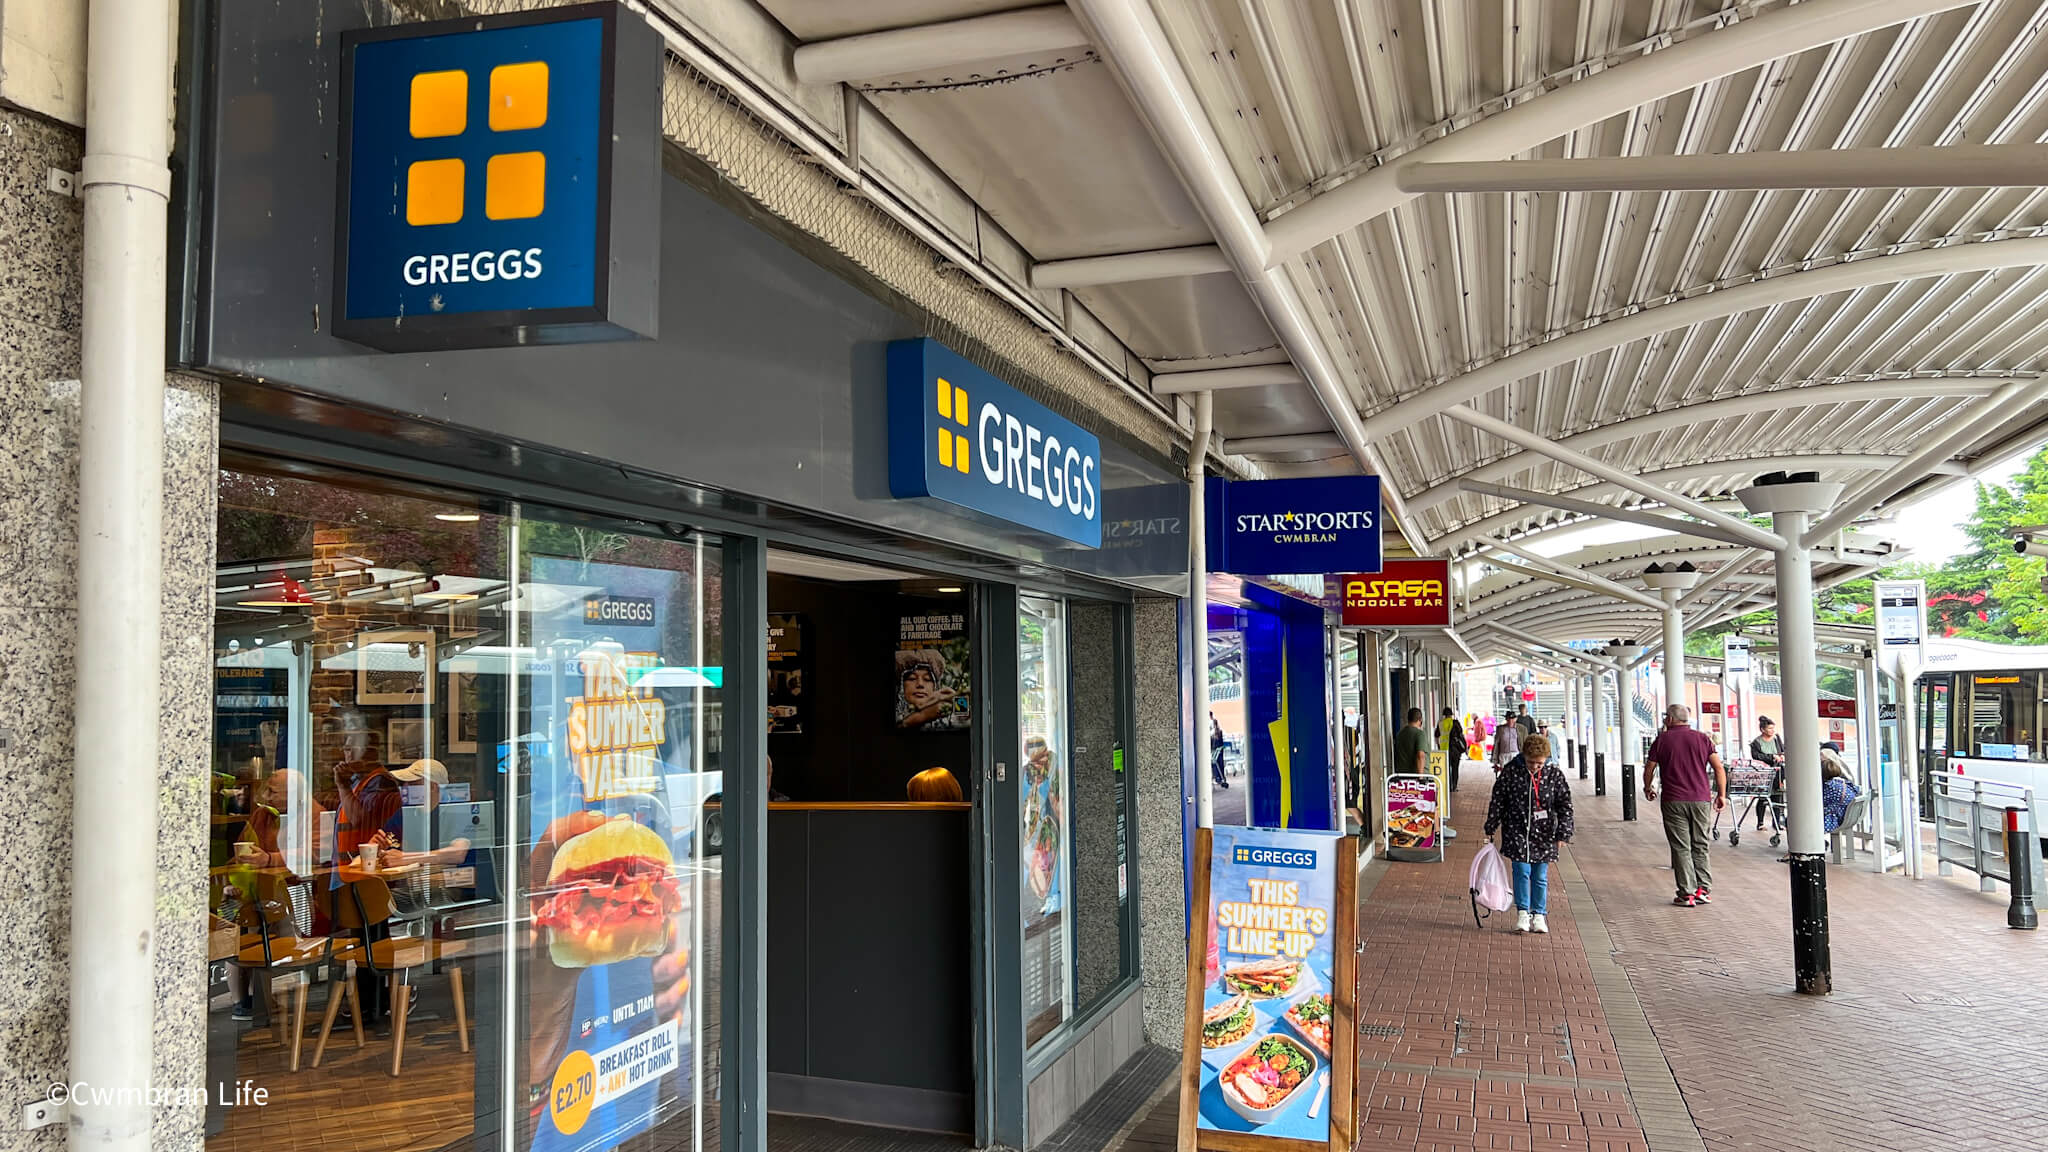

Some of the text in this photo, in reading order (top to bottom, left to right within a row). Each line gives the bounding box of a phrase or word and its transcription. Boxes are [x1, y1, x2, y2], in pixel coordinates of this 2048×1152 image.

[403, 247, 543, 286] GREGGS
[978, 402, 1096, 521] GREGGS
[1236, 510, 1373, 533] STAR SPORTS
[1273, 533, 1337, 544] CWMBRAN
[1346, 579, 1443, 599] ASAGA
[600, 600, 653, 621] GREGGS
[1346, 598, 1443, 608] NOODLE BAR
[1895, 598, 1904, 607] B
[929, 623, 963, 631] CHOCOLATE
[952, 615, 963, 623] TEA
[907, 631, 942, 640] FAIRTRADE
[570, 699, 665, 752] SUMMER
[581, 747, 657, 801] VALUE
[1251, 849, 1313, 866] GREGGS
[1248, 879, 1299, 906] THIS
[1218, 902, 1327, 935] SUMMER'S
[1228, 928, 1315, 958] LINE-UP
[612, 994, 655, 1024] UNTIL 11AM
[581, 1020, 592, 1033] HP
[599, 1029, 672, 1077] BREAKFAST ROLL
[607, 1068, 627, 1094] ANY
[629, 1060, 646, 1084] HOT
[556, 1071, 593, 1114] £2.70
